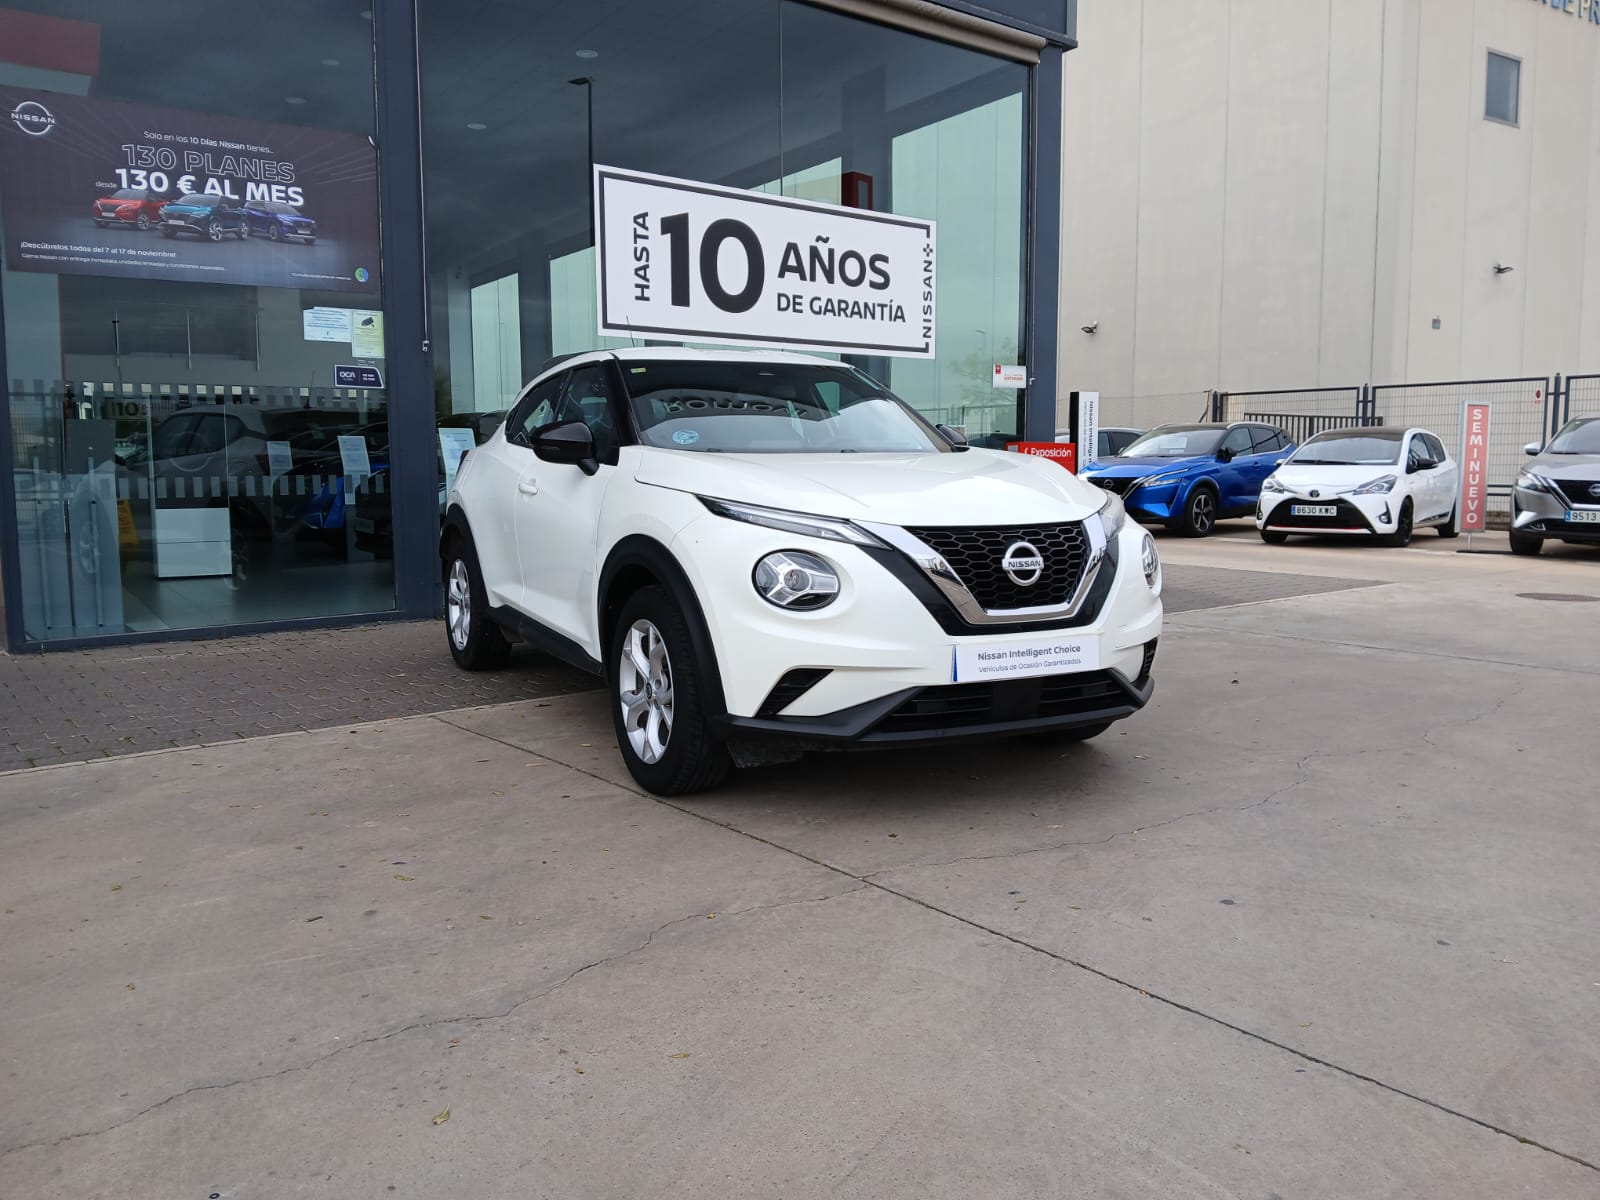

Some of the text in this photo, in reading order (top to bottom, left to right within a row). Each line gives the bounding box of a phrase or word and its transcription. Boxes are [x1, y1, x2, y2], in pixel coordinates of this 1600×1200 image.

[11, 112, 56, 124] NISSAN
[190, 136, 199, 144] 10
[219, 140, 246, 150] Nissan
[121, 143, 296, 184] 130 PLANES
[95, 168, 305, 207] desde 130 € AL MES
[70, 245, 92, 253] todos
[92, 246, 104, 254] del
[127, 248, 137, 256] de
[632, 211, 652, 302] HASTA
[660, 211, 766, 314] 10
[777, 235, 891, 291] AÑOS
[776, 292, 907, 323] DE GARANTÍA
[922, 259, 934, 339] NISSAN
[1030, 446, 1072, 458] Exposición
[1465, 408, 1483, 524] SEMINUEVO
[1571, 511, 1597, 521] 9513
[1007, 560, 1042, 569] NISSAN
[977, 644, 1081, 661] Nissan Intelligent Choice
[978, 658, 1082, 673] Vehículos de Ocasión Garantizados
